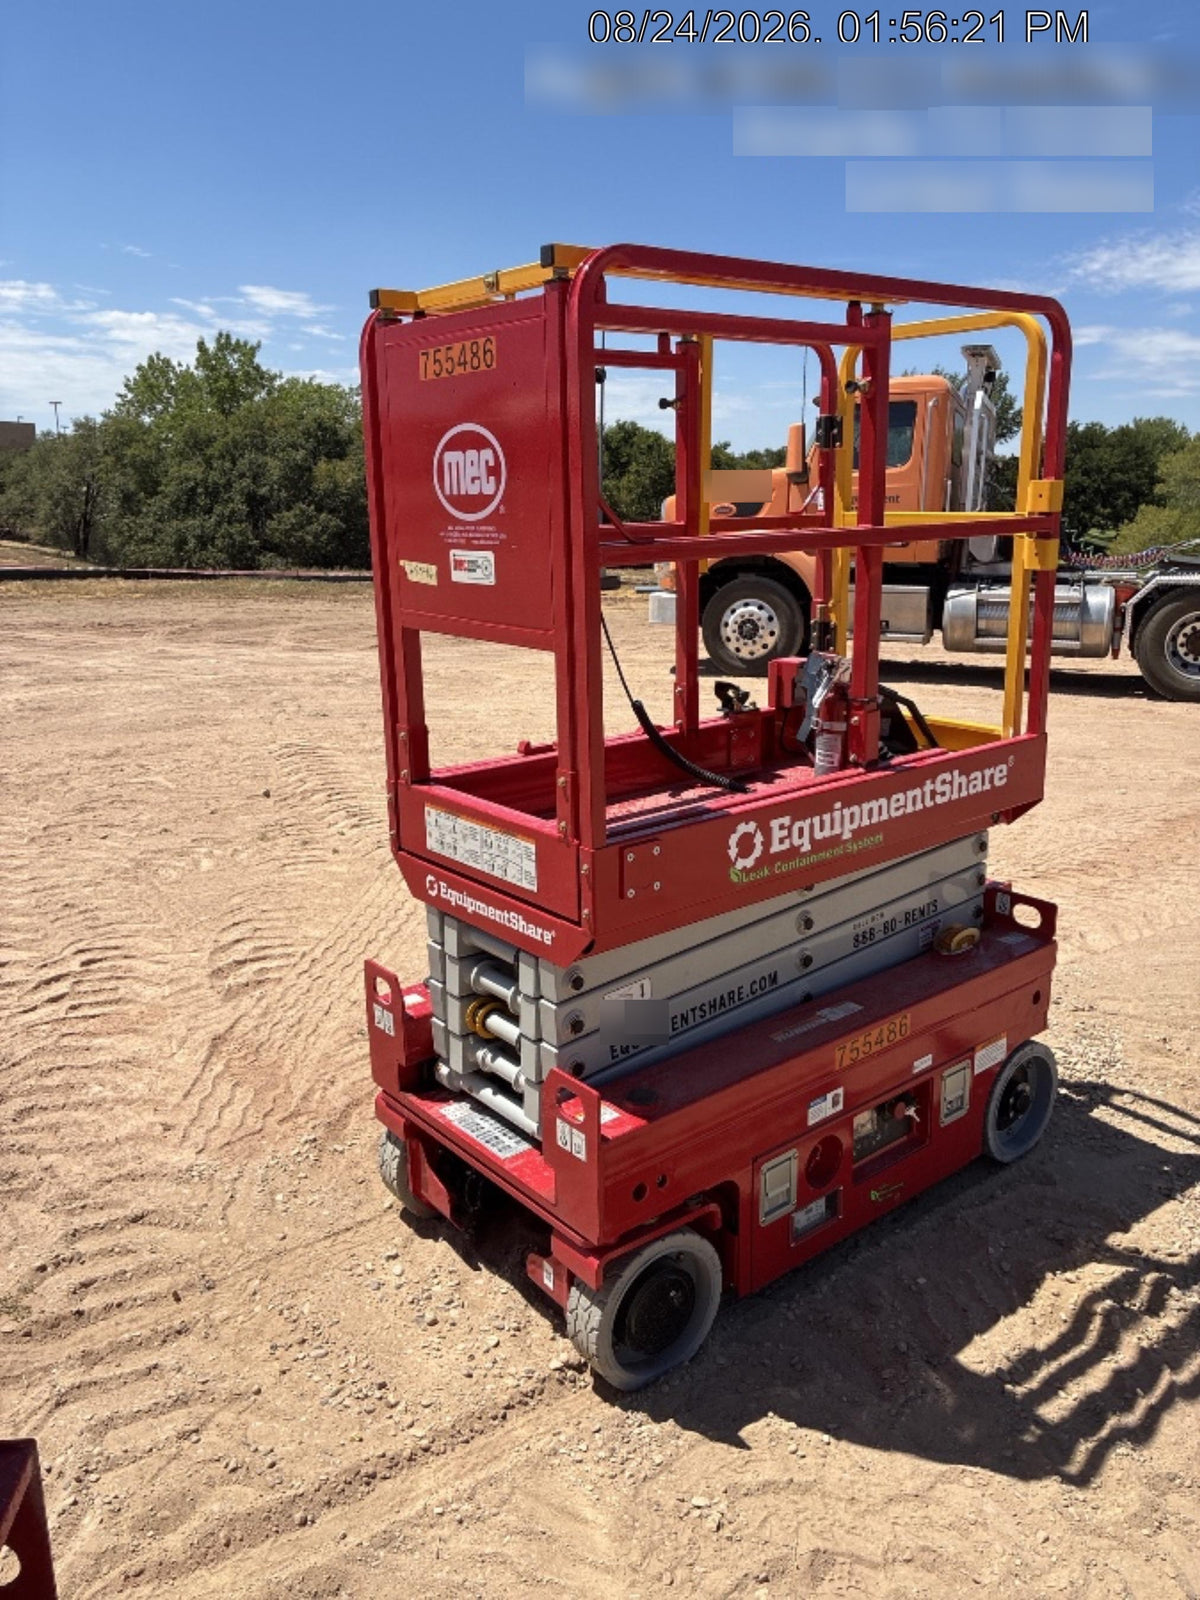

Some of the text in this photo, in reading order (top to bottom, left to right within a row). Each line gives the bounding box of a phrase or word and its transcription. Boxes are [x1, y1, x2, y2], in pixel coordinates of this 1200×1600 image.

[420, 337, 495, 379] 755486
[769, 762, 1008, 854] EquipmentShare
[742, 866, 771, 883] Leak
[774, 846, 844, 873] Containment
[439, 880, 553, 945] EquipmentShare
[837, 1014, 910, 1068] 755486
